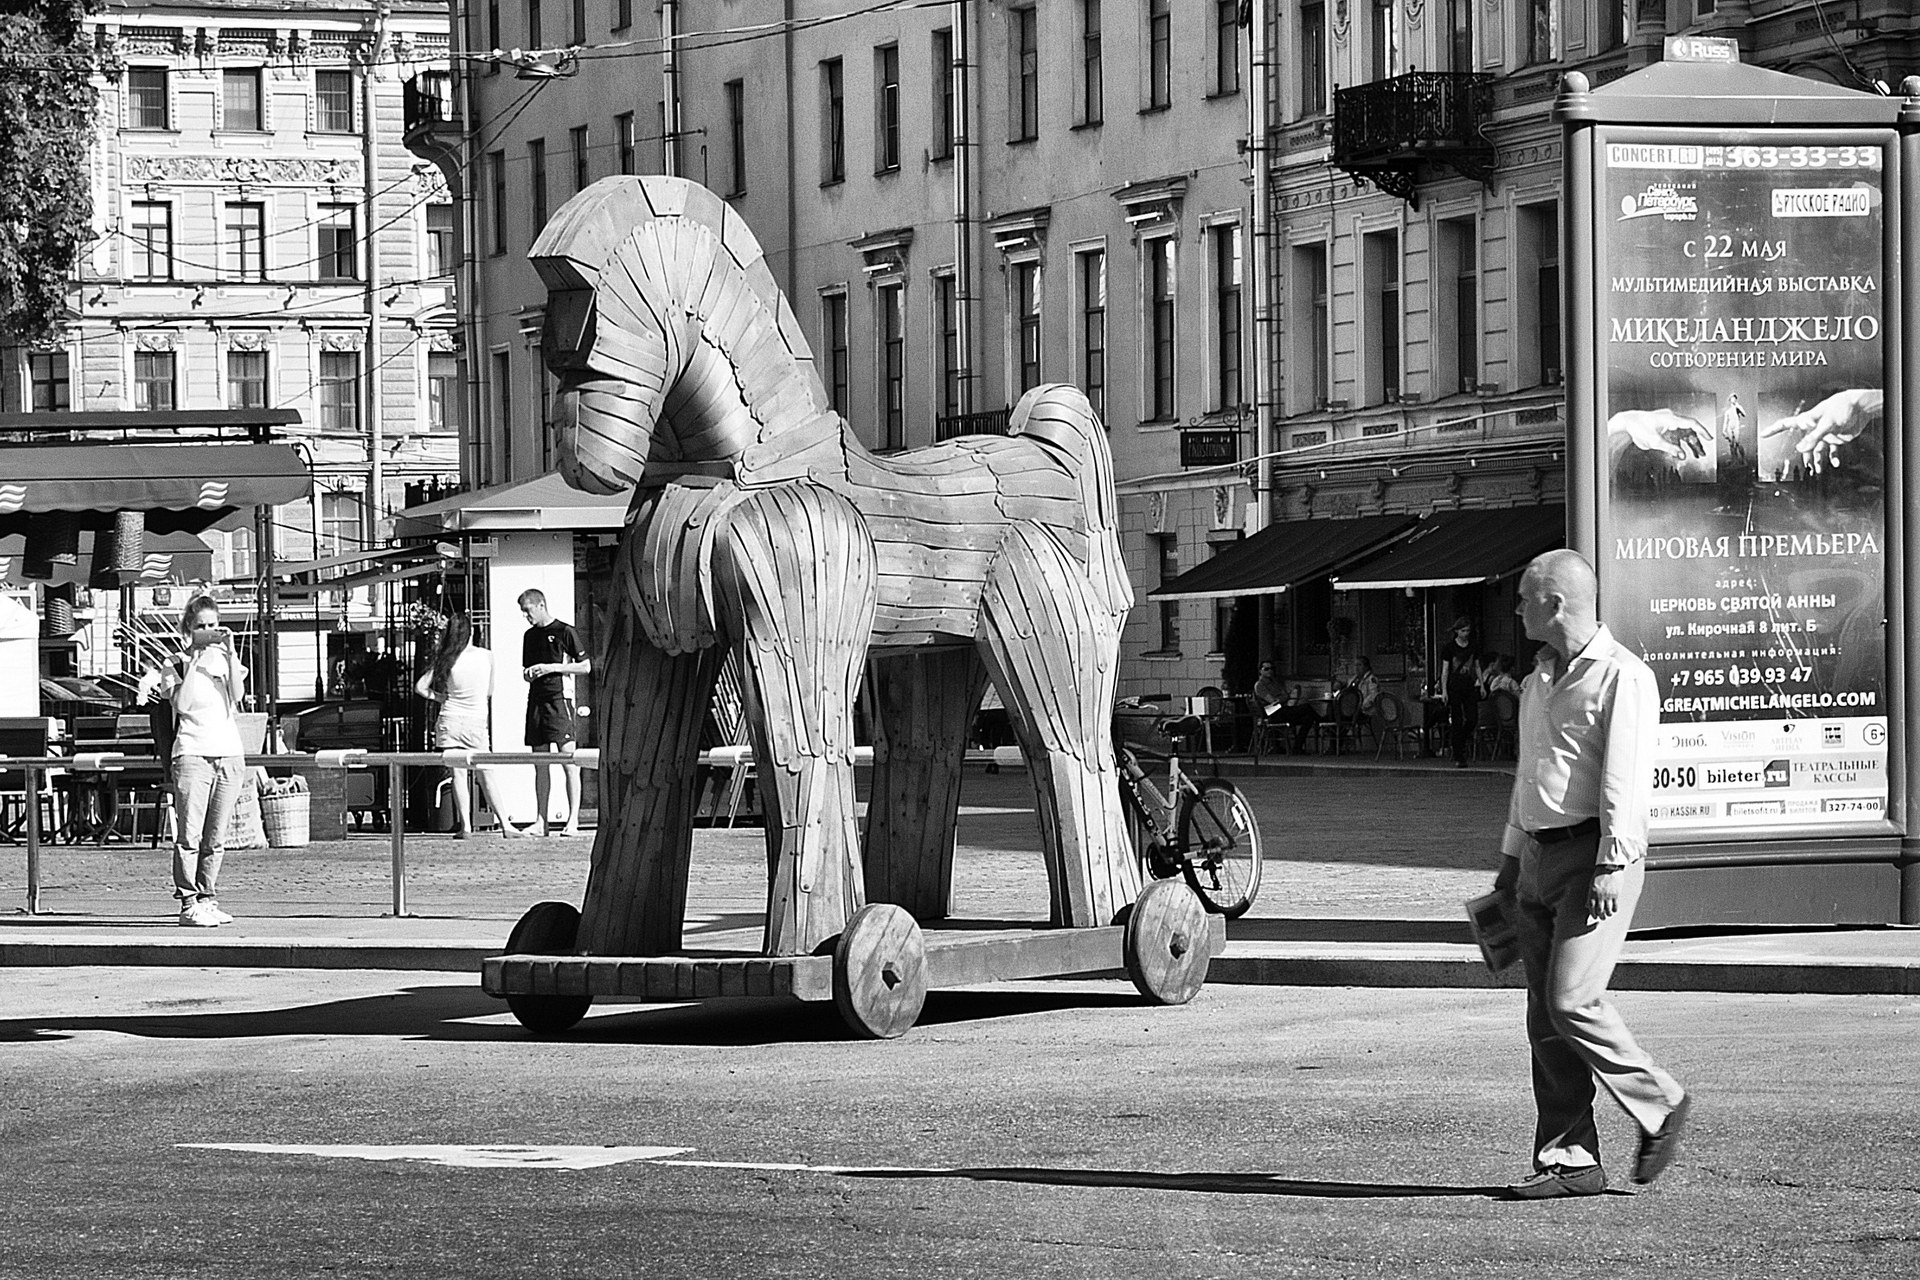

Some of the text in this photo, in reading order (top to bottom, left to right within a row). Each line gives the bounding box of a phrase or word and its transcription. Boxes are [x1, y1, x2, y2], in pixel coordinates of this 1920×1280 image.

[1725, 146, 1877, 168] 363-33-33
[1832, 193, 1867, 212] РАДИО
[1704, 236, 1733, 258] 22
[1742, 241, 1787, 261] МАЯ
[1611, 275, 1876, 296] МУЛЬТИМЕДИЙНАЯ ВЫСТАВКА
[1610, 315, 1879, 347] МИКЕЛАНДЖЕЛО
[1650, 351, 1828, 369] СОТВОРЕНИЕ МИРА
[1615, 532, 1880, 560] МИРОВАЯ ПРЕМЬЕРА
[1715, 578, 1757, 589] адрес:
[1650, 593, 1836, 614] ЦЕРКОВЬ СВЯТОЙ АННЫ
[1666, 619, 1817, 638] ул. Кирочная 8 лит. Б
[1643, 646, 1842, 662] дополнительная информация:
[1671, 671, 1690, 686] +7
[1694, 670, 1725, 685] 965
[1765, 667, 1787, 683] 93
[1790, 666, 1813, 682] 47
[1659, 691, 1876, 713] .GREATMICHELANGELO.COM
[1793, 760, 1880, 772] ТЕАТРАЛЬНЫЕ
[1813, 773, 1857, 783] КАССЫ
